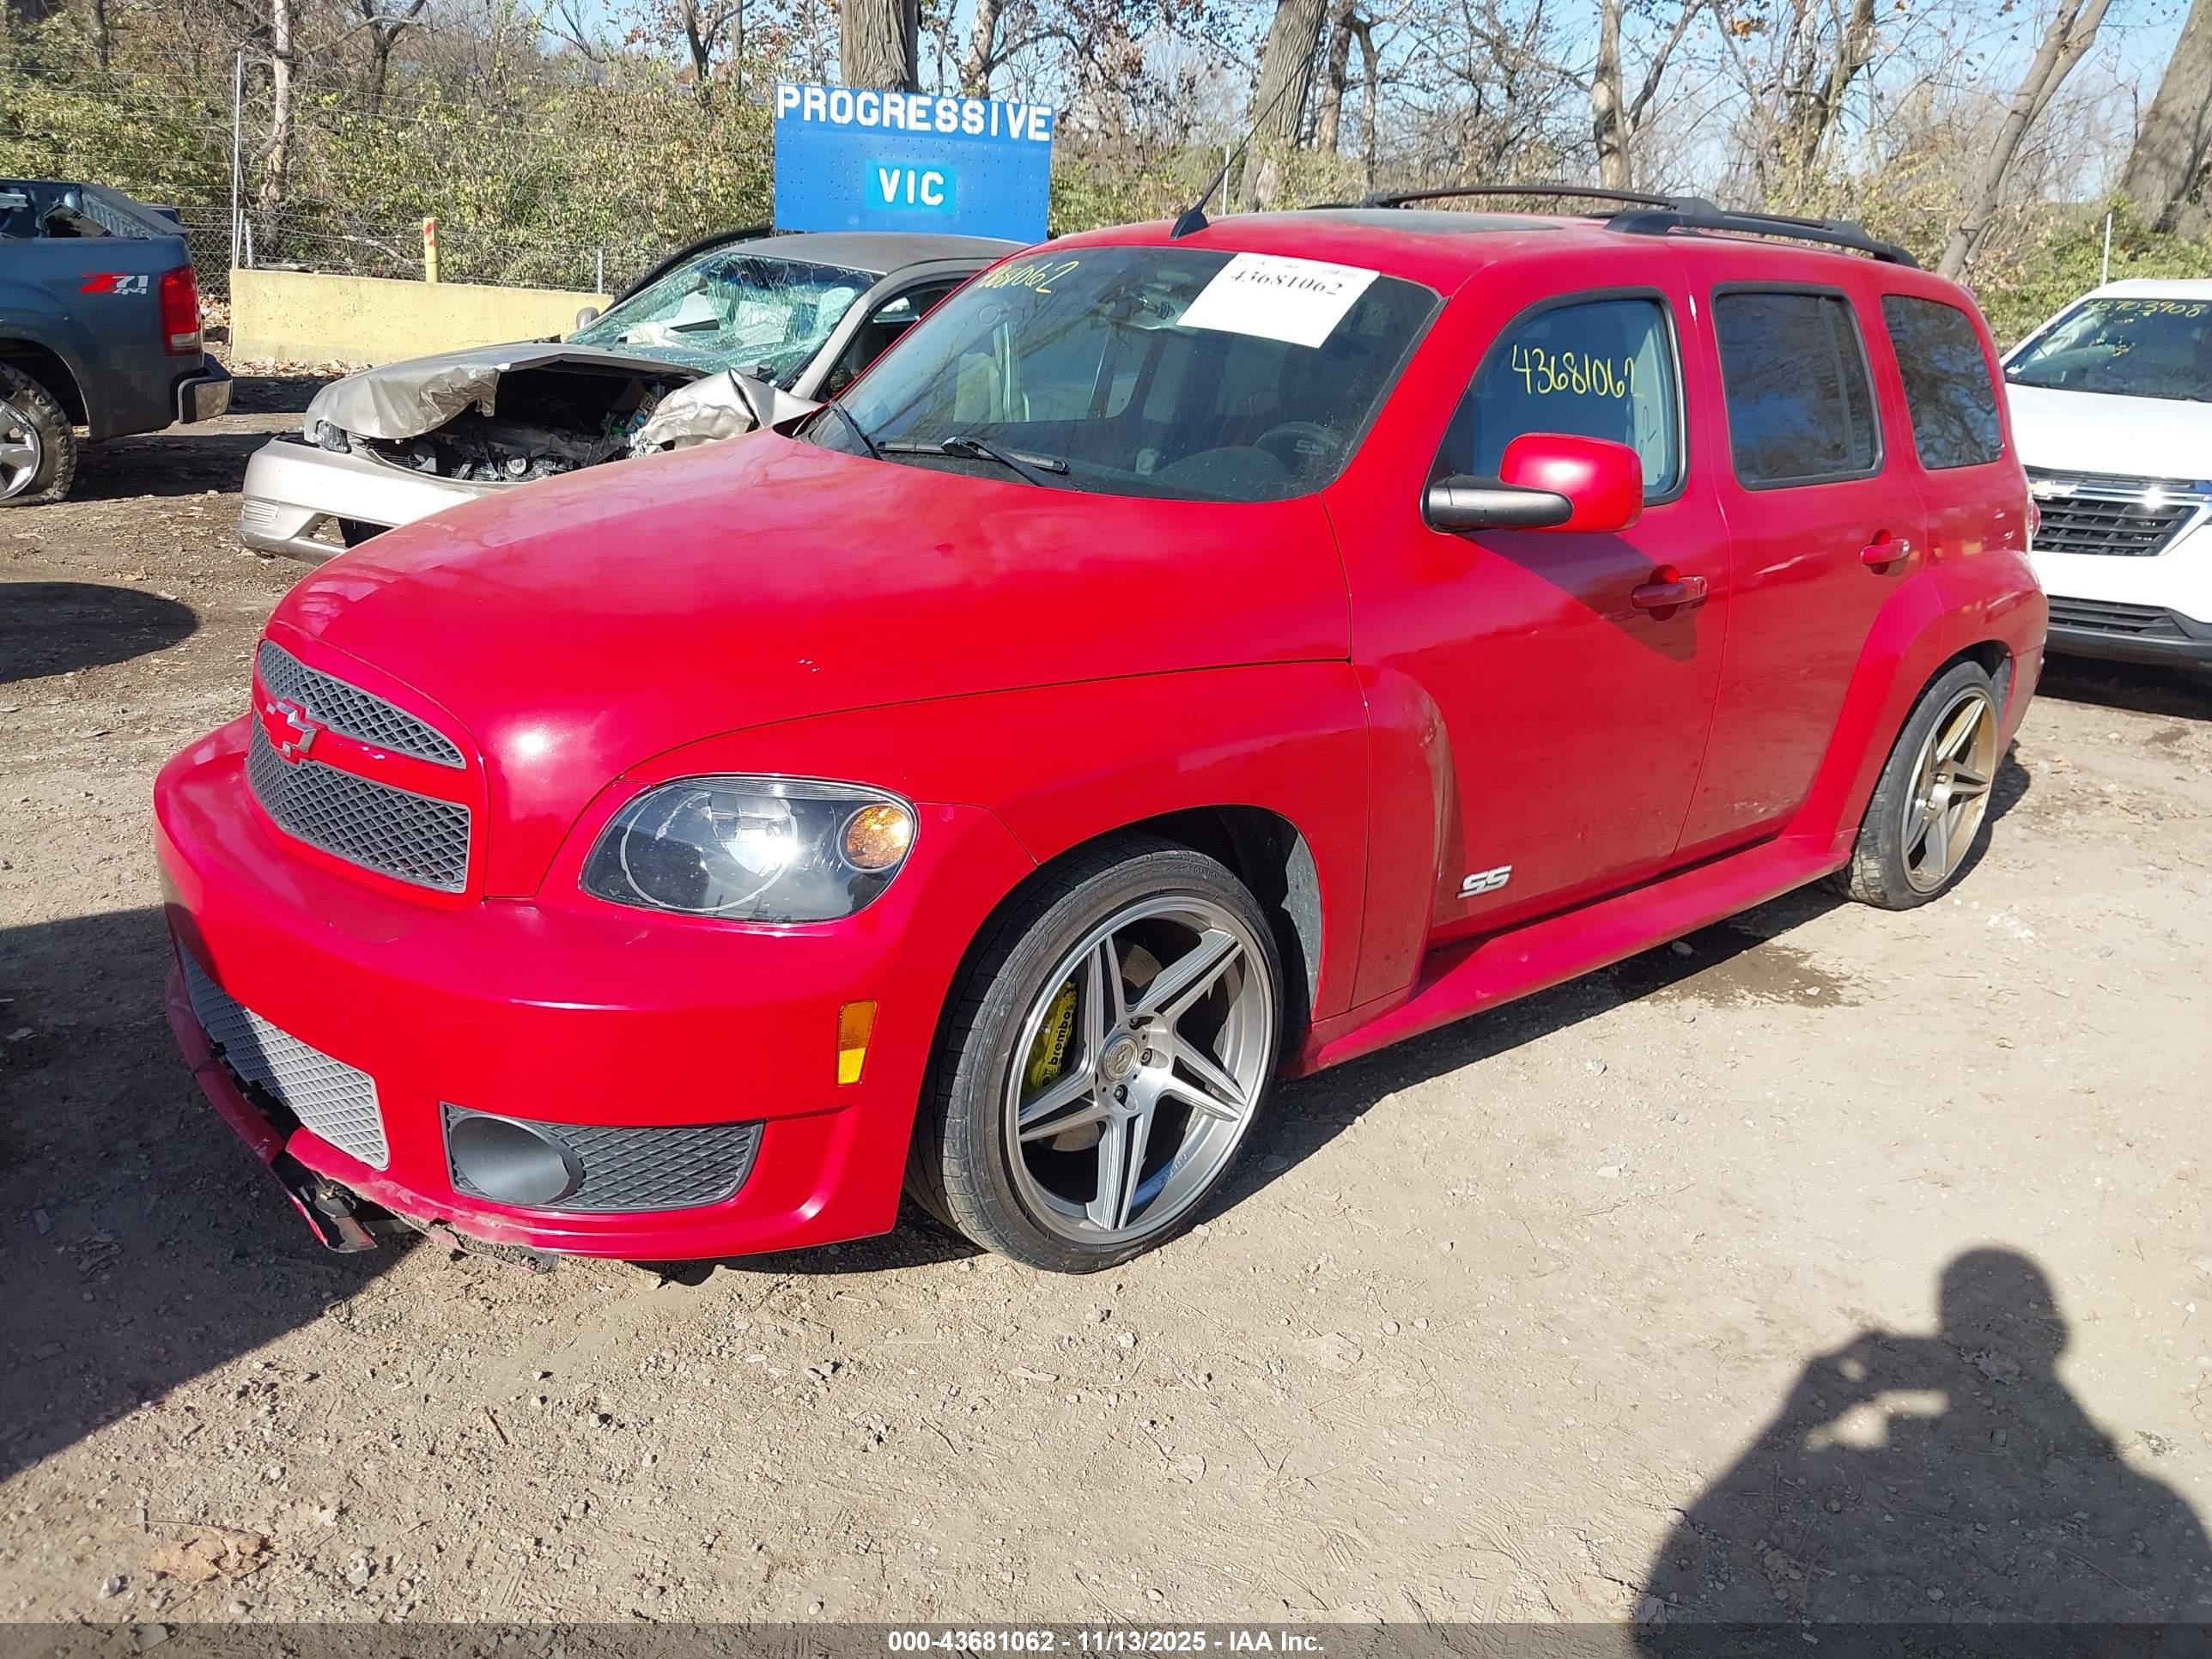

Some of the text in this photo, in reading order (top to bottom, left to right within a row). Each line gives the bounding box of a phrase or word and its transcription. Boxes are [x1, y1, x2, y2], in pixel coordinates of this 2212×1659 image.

[776, 84, 1051, 142] PROGRESSIVE
[878, 167, 945, 206] VIC
[80, 272, 149, 295] Z71
[1231, 270, 1343, 295] 43681062
[1511, 344, 1644, 398] 43681062
[1456, 865, 1512, 899] SS
[1048, 1011, 1073, 1066] brembo
